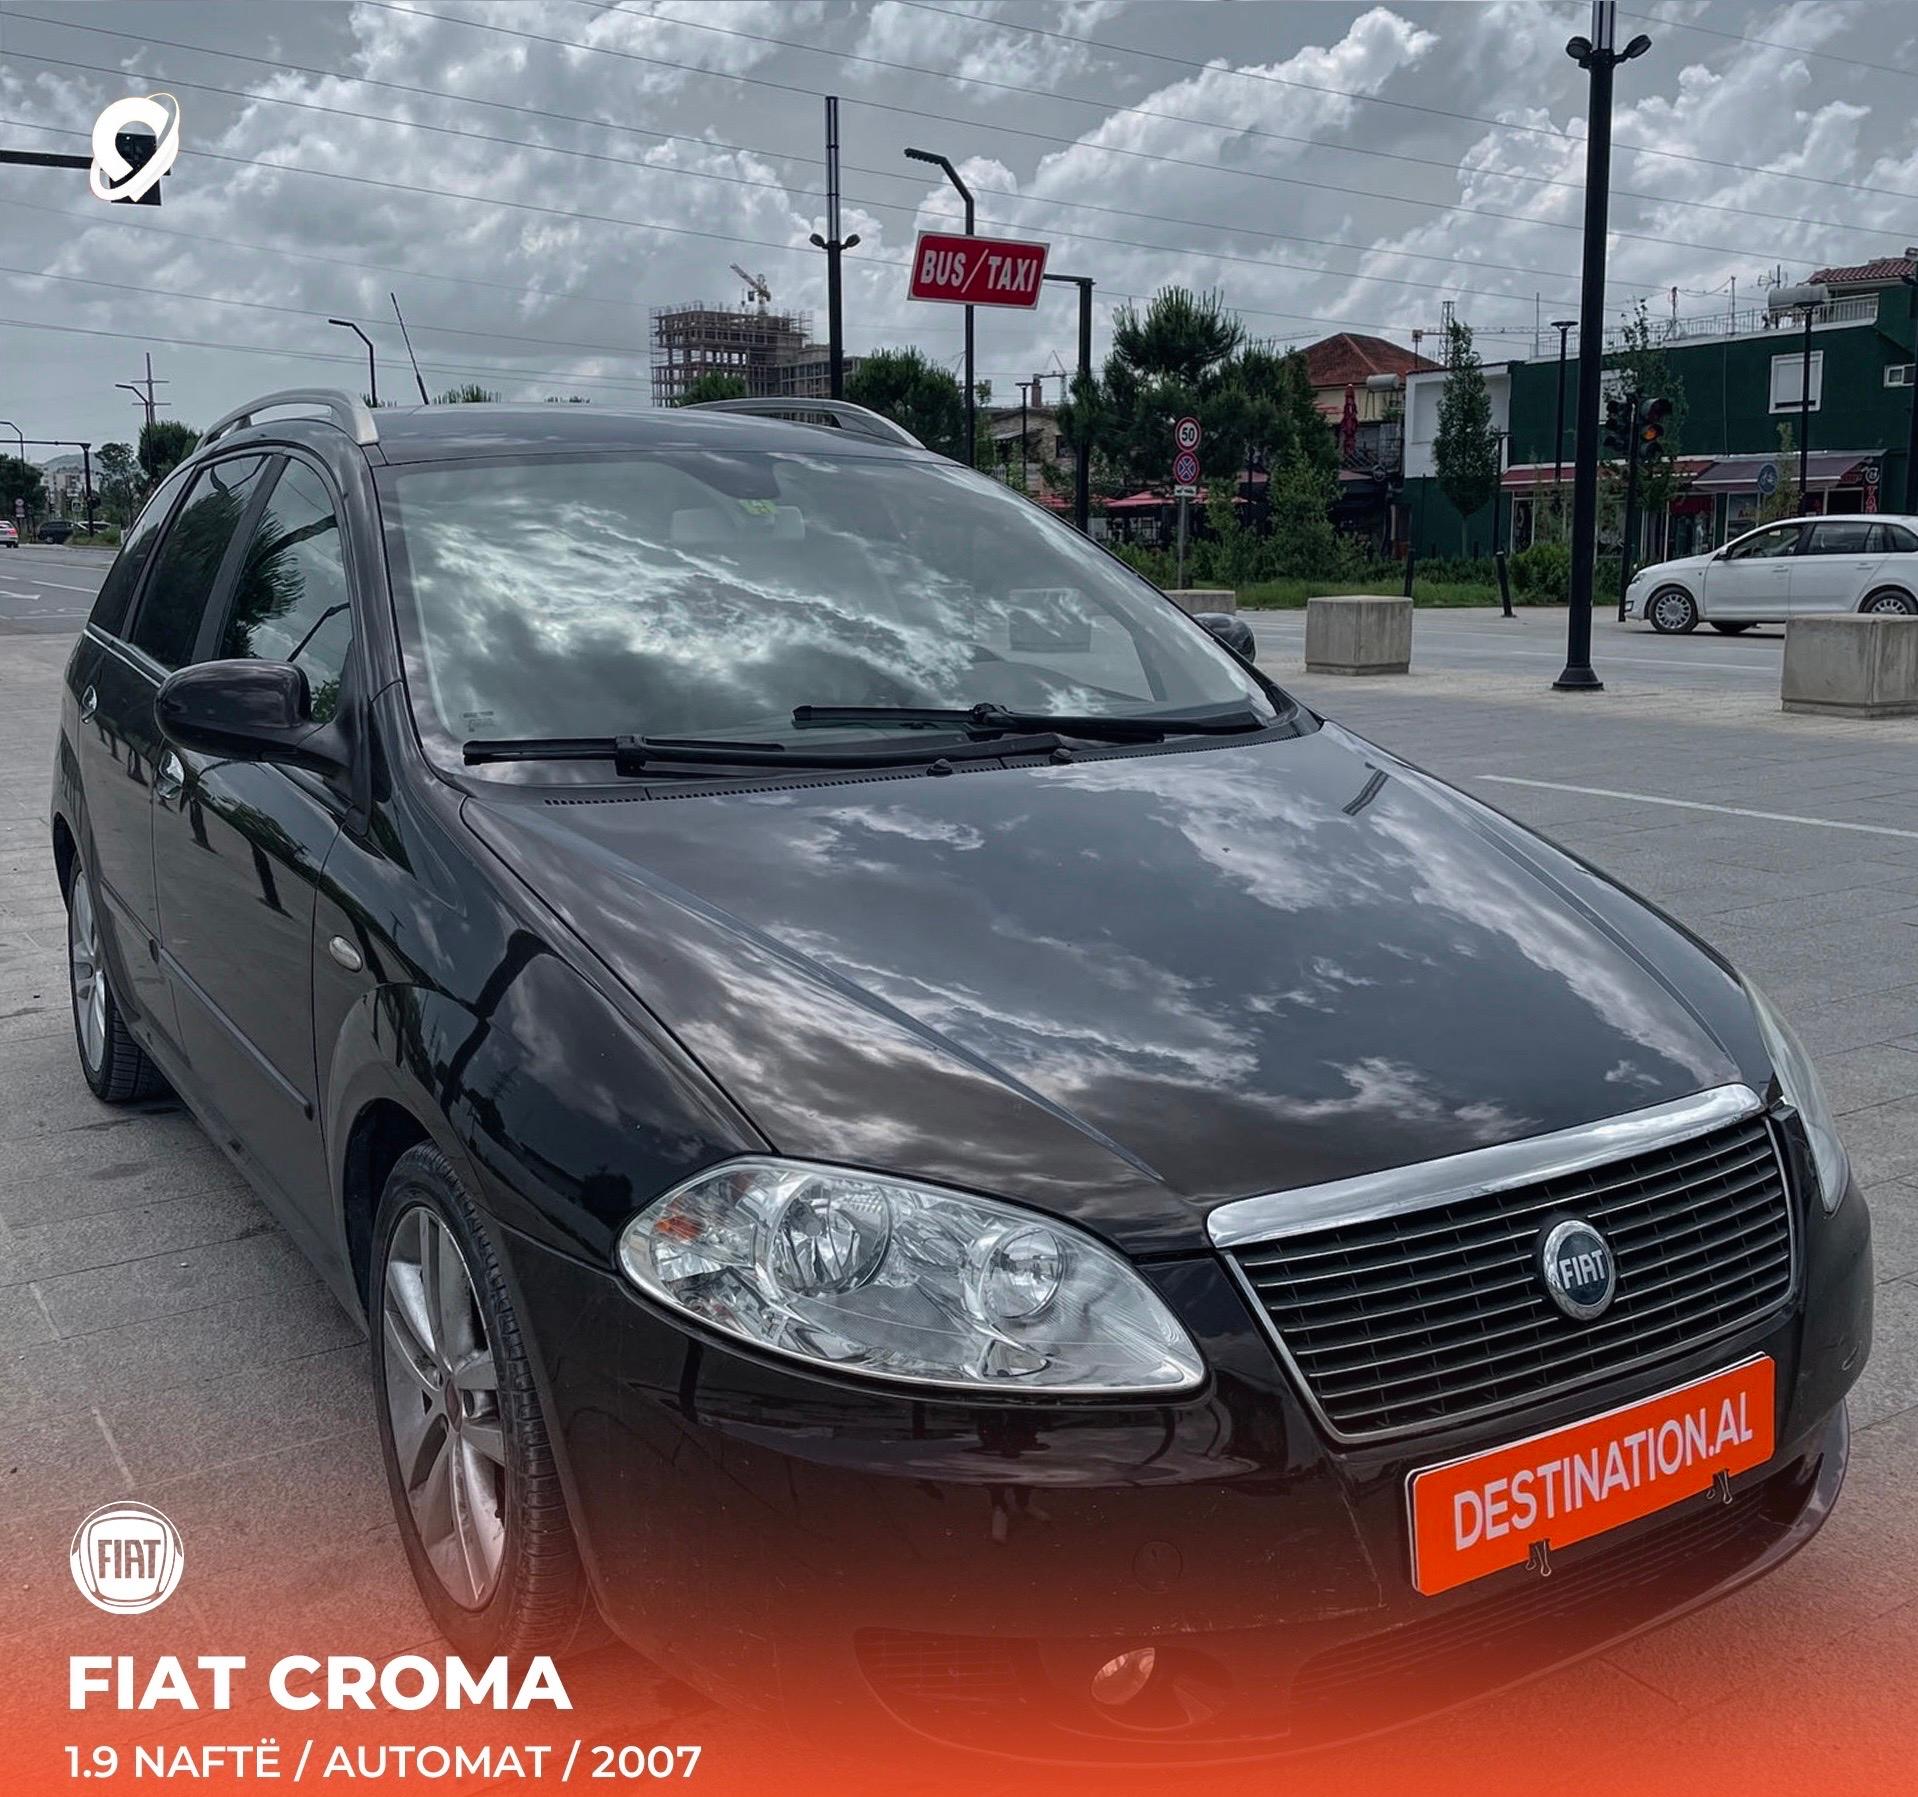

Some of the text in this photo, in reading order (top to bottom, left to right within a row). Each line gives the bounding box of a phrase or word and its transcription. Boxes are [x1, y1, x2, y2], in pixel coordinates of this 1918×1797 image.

[1181, 427, 1196, 442] 50
[1559, 1249, 1606, 1290] FIAT
[1453, 1391, 1754, 1552] DESTINATION.AL
